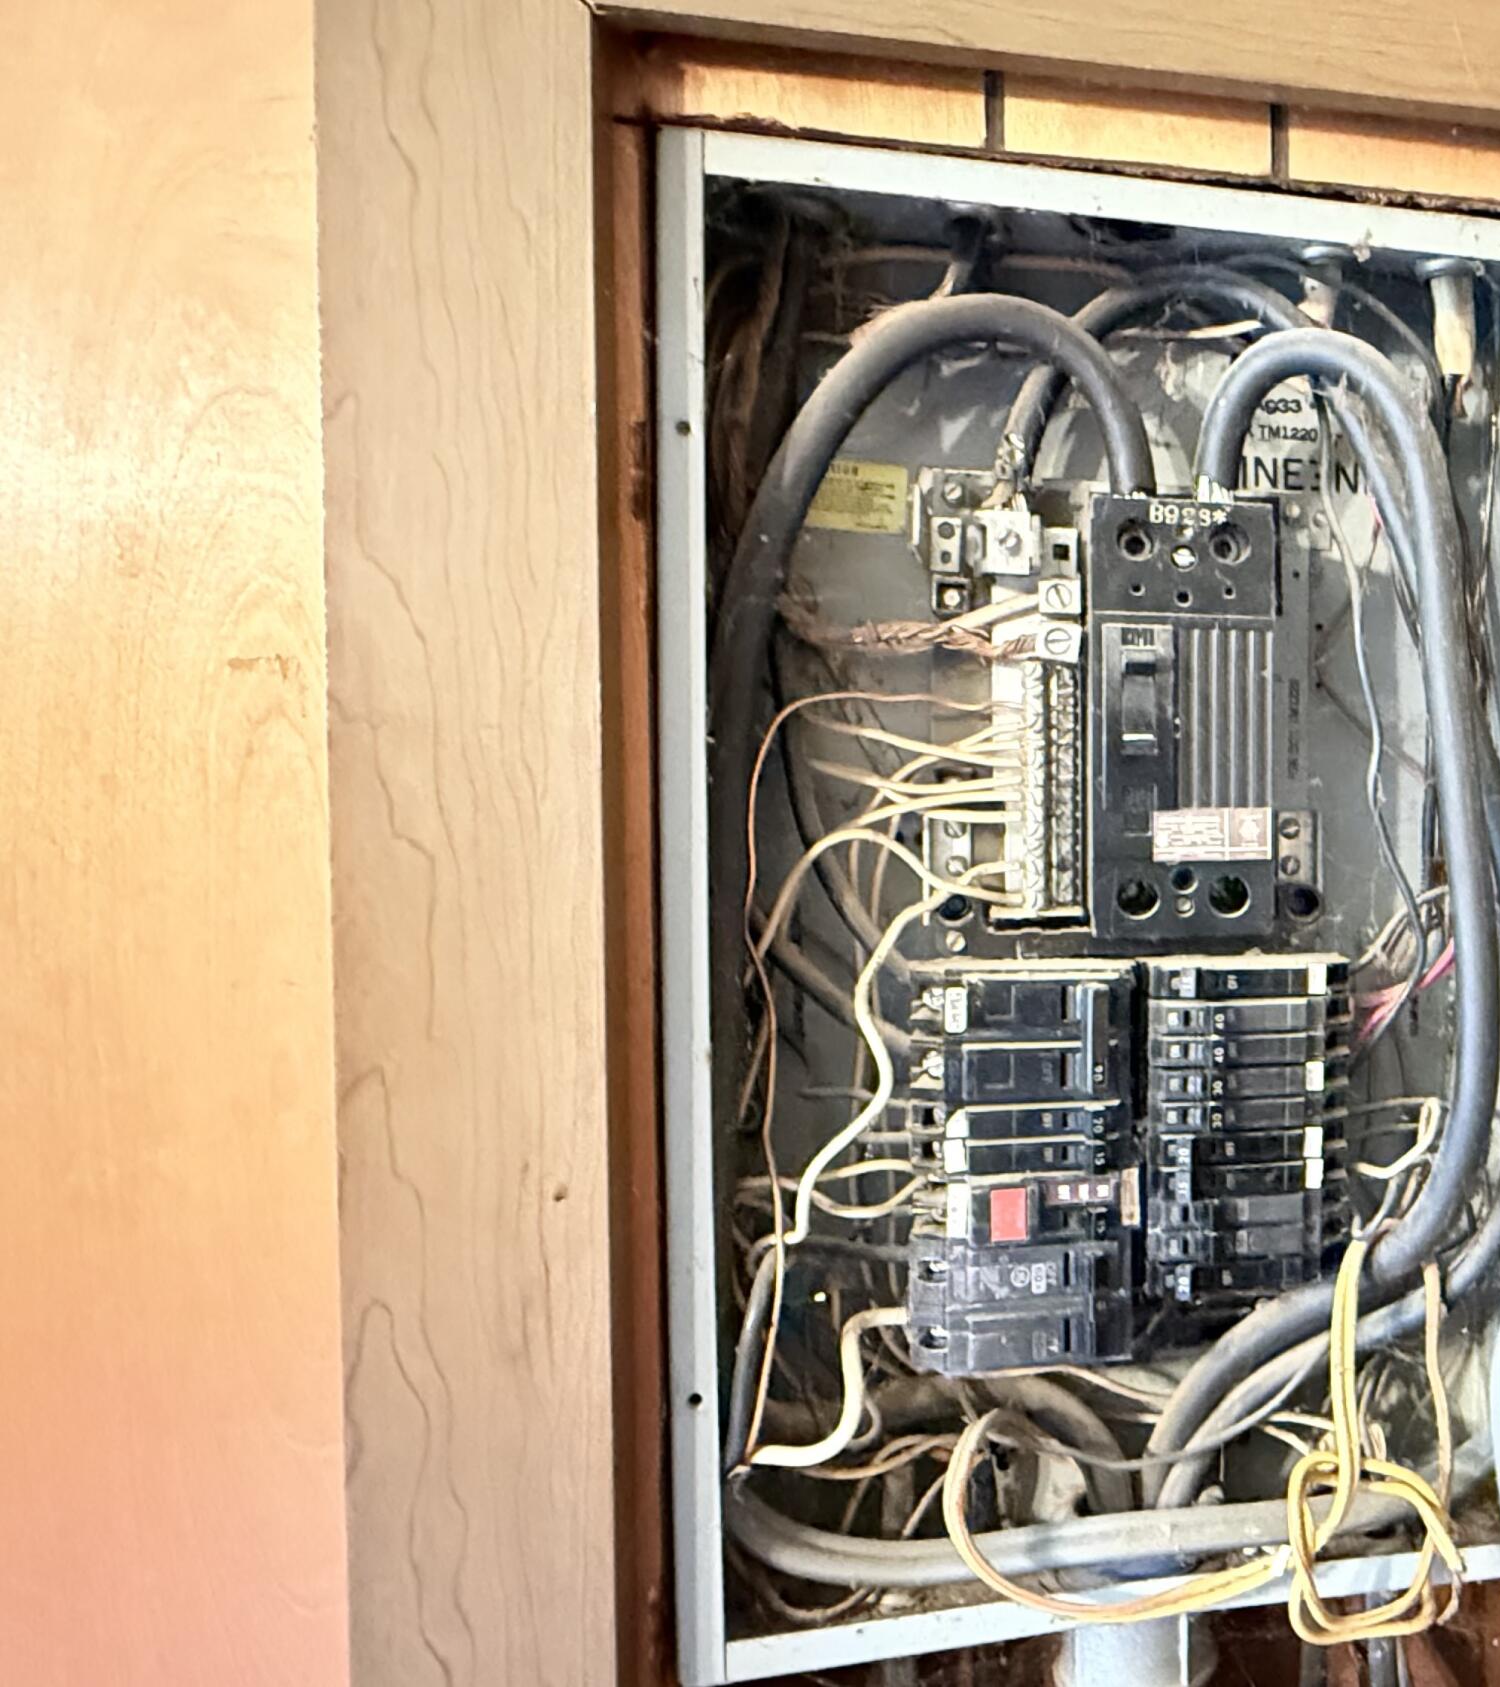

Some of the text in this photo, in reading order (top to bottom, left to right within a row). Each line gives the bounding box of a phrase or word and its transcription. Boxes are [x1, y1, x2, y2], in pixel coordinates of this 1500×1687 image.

[1258, 424, 1319, 443] TM1220
[1214, 1013, 1225, 1030] 40
[1214, 1047, 1225, 1064] 40
[1177, 1147, 1189, 1164] 20
[1177, 1276, 1189, 1293] 20
